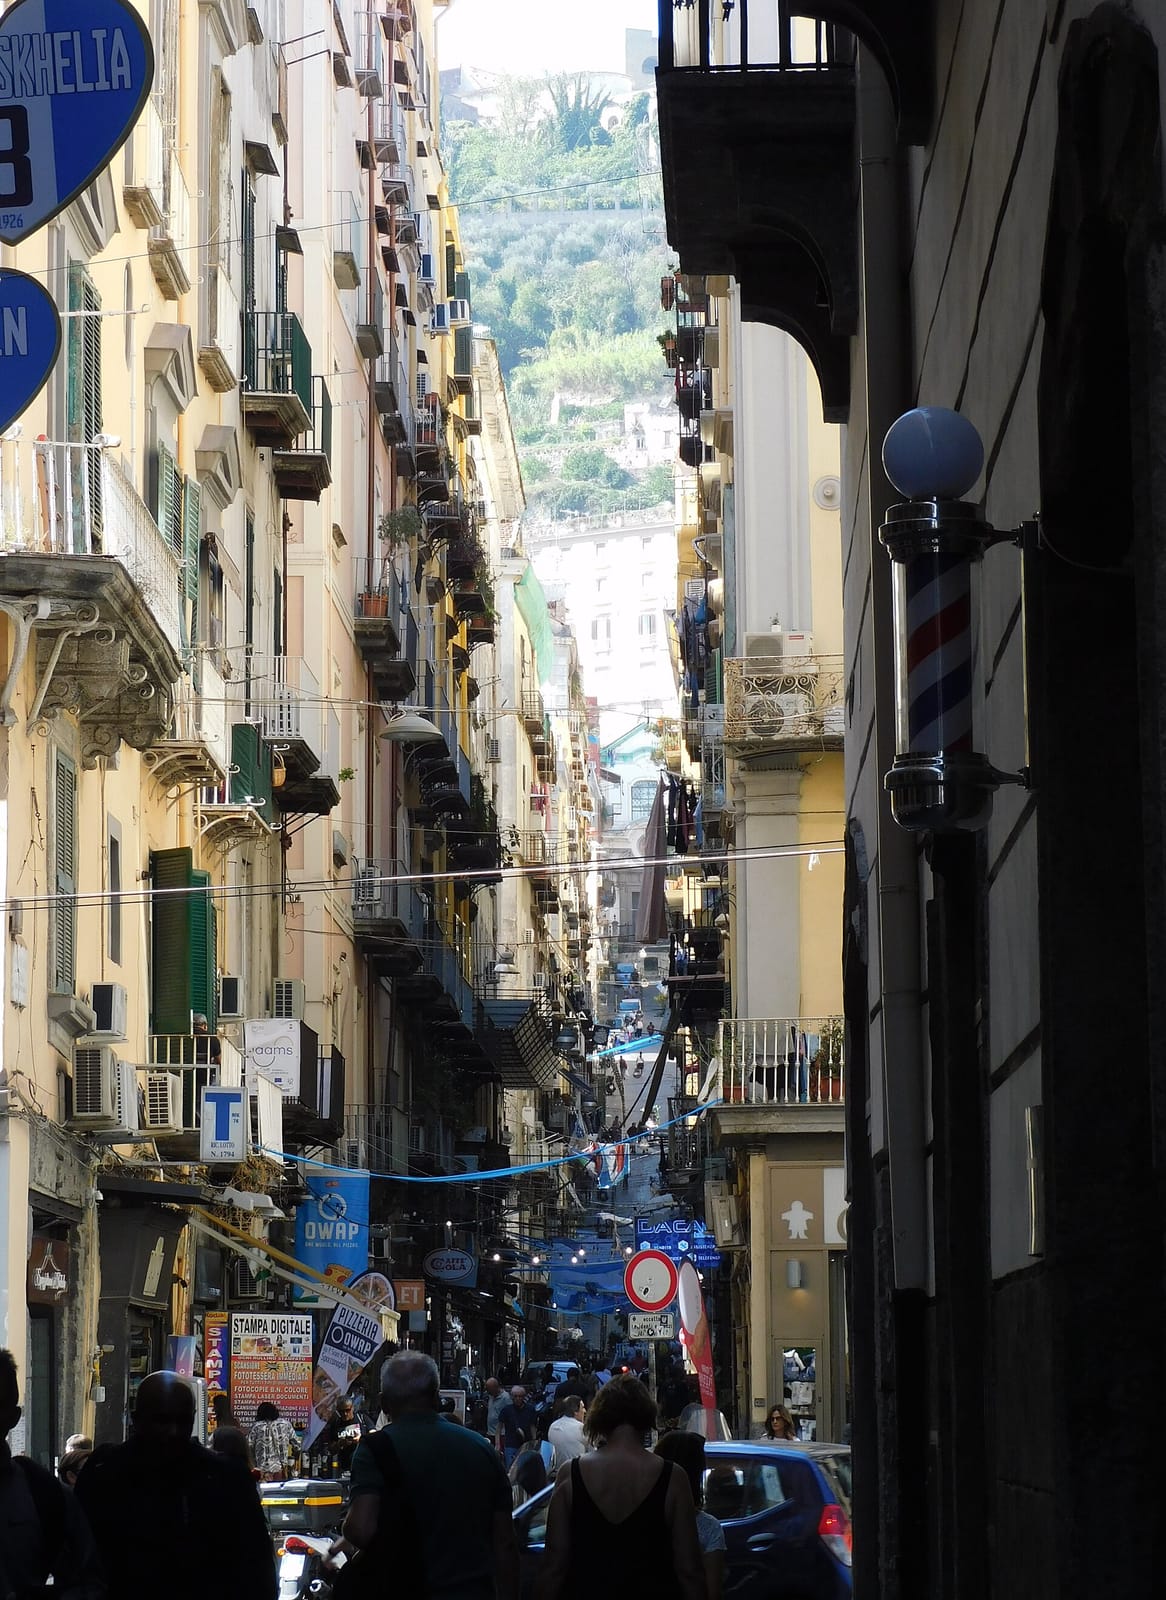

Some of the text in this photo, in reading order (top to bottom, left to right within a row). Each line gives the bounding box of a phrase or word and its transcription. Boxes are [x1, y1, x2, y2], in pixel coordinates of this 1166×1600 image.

[205, 1093, 241, 1140] T
[305, 1221, 359, 1240] OWAP
[233, 1318, 310, 1335] STAMPA DIGITALE
[338, 1307, 379, 1340] PIZZERIA
[344, 1332, 372, 1355] OWAP
[206, 1327, 222, 1390] STAMPA
[234, 1371, 309, 1381] FOTOTESSERA IMMEDIATA
